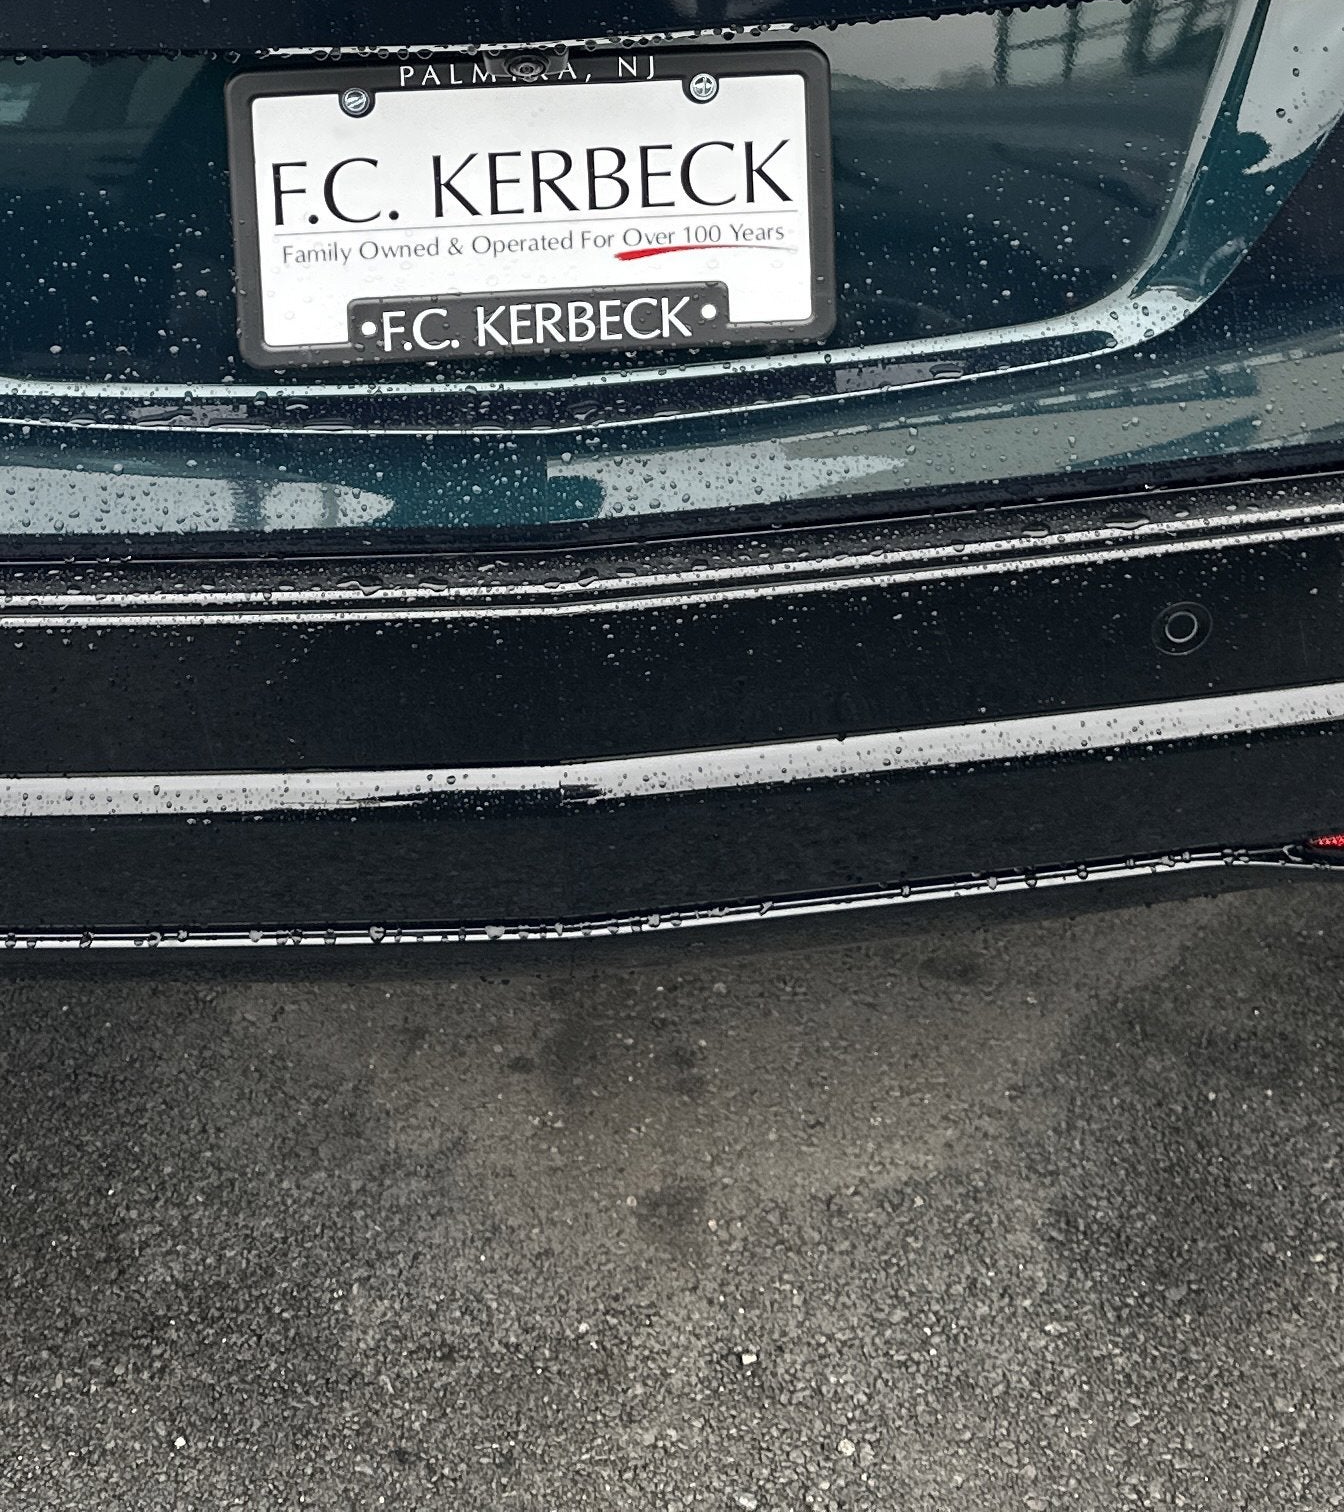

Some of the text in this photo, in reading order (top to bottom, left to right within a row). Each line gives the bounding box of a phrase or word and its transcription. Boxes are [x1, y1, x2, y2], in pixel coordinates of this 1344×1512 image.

[399, 55, 654, 87] PALMA, NJ
[272, 138, 794, 226] F.C. KERBECK
[283, 222, 785, 266] Family Owned & Operated For Over 100 Years
[382, 296, 693, 352] F.C. KERBECK
